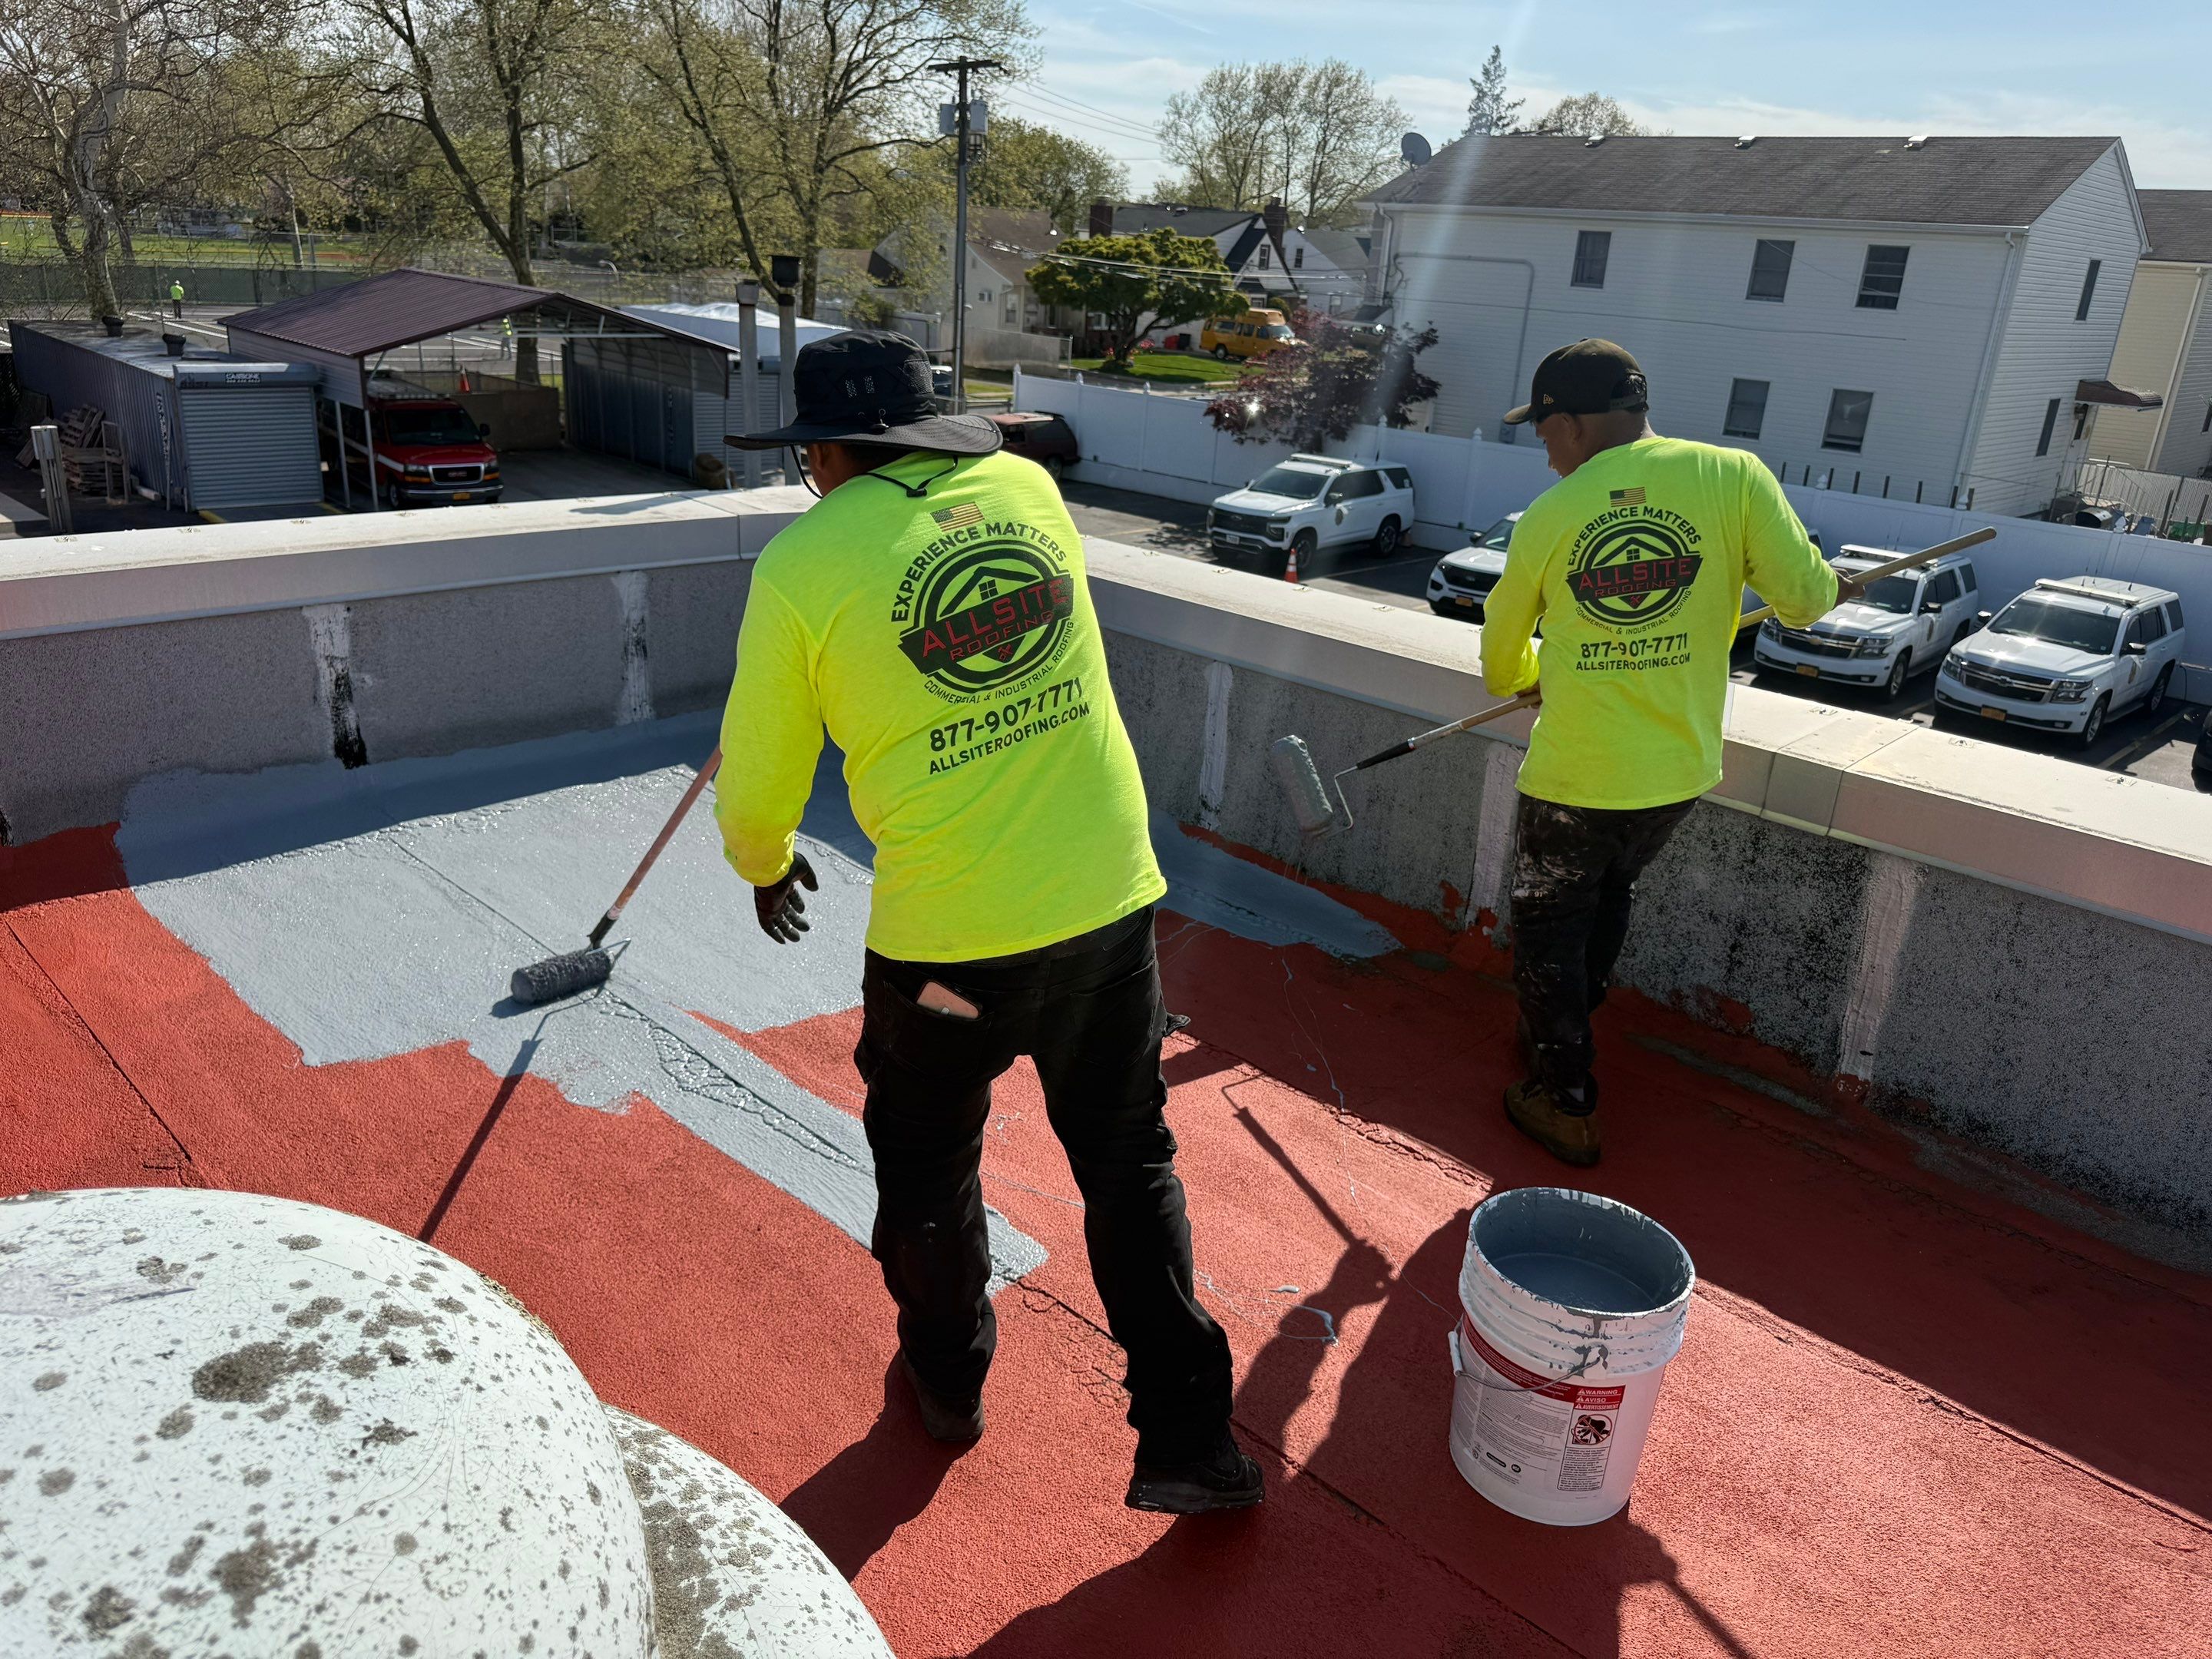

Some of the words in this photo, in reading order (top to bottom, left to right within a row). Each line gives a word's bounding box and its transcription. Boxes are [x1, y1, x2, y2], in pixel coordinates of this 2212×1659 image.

[1568, 506, 1638, 566] EXPERIENCE
[1643, 505, 1701, 545] MATTERS
[891, 526, 981, 622] EXPERIENCE
[986, 522, 1067, 562] MATTERS
[1578, 558, 1694, 591] ALLSITE
[1594, 578, 1677, 597] ROOFING
[922, 578, 1069, 657] ALLSITE
[949, 610, 1054, 661] ROOFING
[1575, 606, 1613, 633] COMMERCIAL
[1616, 627, 1622, 635] &
[1625, 618, 1668, 635] INDUSTRIAL
[1669, 589, 1691, 618] ROOFING
[995, 664, 1053, 700] INDUSTRIAL
[1052, 621, 1074, 664] ROOFING
[1576, 652, 1690, 671] ALLSITEROOFING.COM
[1581, 632, 1688, 658] 877-907-7771
[930, 677, 1082, 752] 877-907-7771
[930, 702, 1090, 775] ALLSITEROOFING.COM
